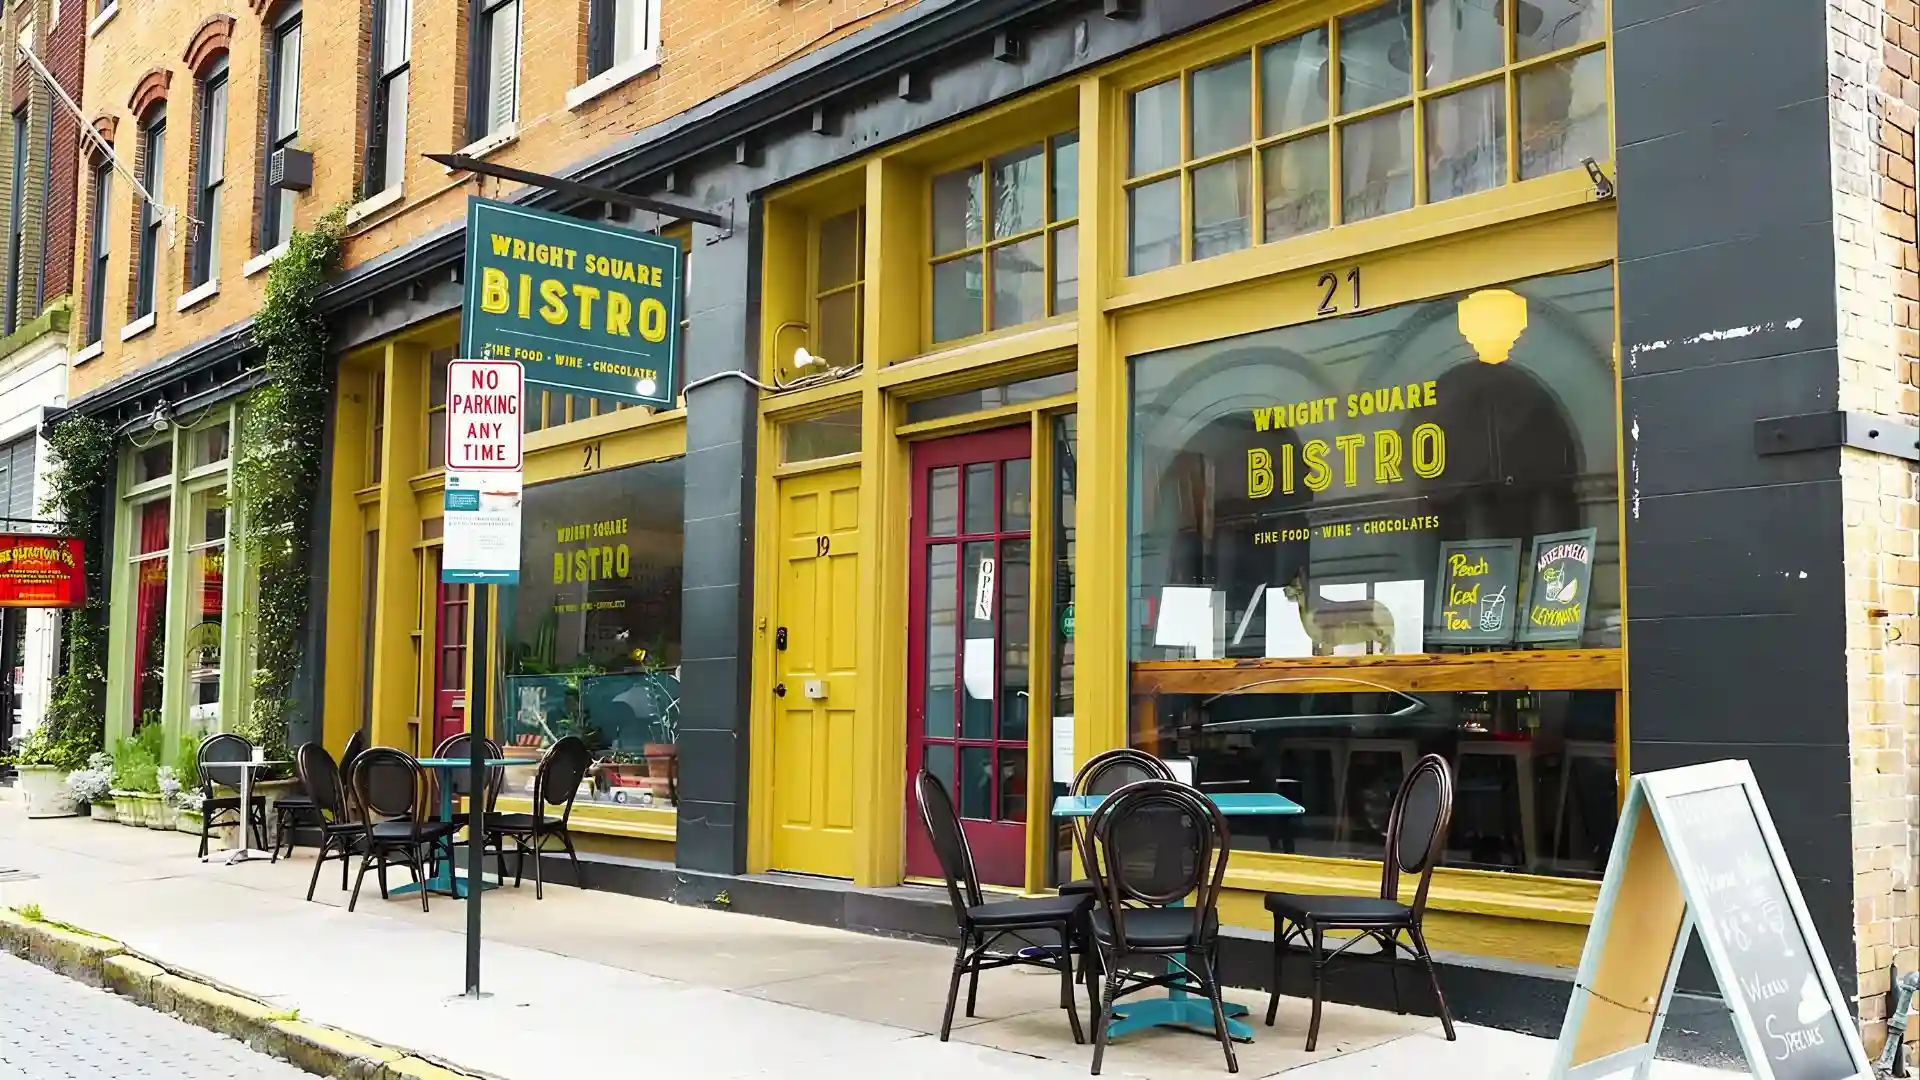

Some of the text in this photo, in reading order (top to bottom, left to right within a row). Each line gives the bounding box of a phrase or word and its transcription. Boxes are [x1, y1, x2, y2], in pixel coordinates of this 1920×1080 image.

[490, 233, 663, 288] WRIGHT SQUARE
[480, 266, 667, 343] BISTRO
[1316, 266, 1360, 315] 21
[472, 369, 499, 389] NO
[515, 347, 543, 362] FOOD
[554, 354, 583, 369] WINE
[592, 361, 657, 381] CHOCOLATES
[453, 394, 517, 415] PARKING
[1253, 380, 1438, 433] WRIGHT SQUARE
[467, 422, 502, 439] ANY
[463, 444, 506, 461] TIME
[583, 441, 601, 472] 21
[1247, 422, 1446, 500] BISTRO
[593, 518, 628, 537] SQUARE
[1254, 515, 1440, 545] FINE FOOD WINE CHOCOLATES
[816, 535, 830, 557] 19
[554, 544, 630, 584] BISTRO
[1448, 553, 1489, 577] Peach
[980, 561, 993, 616] OPEN
[1449, 583, 1481, 608] Iced
[1443, 610, 1472, 631] Tea
